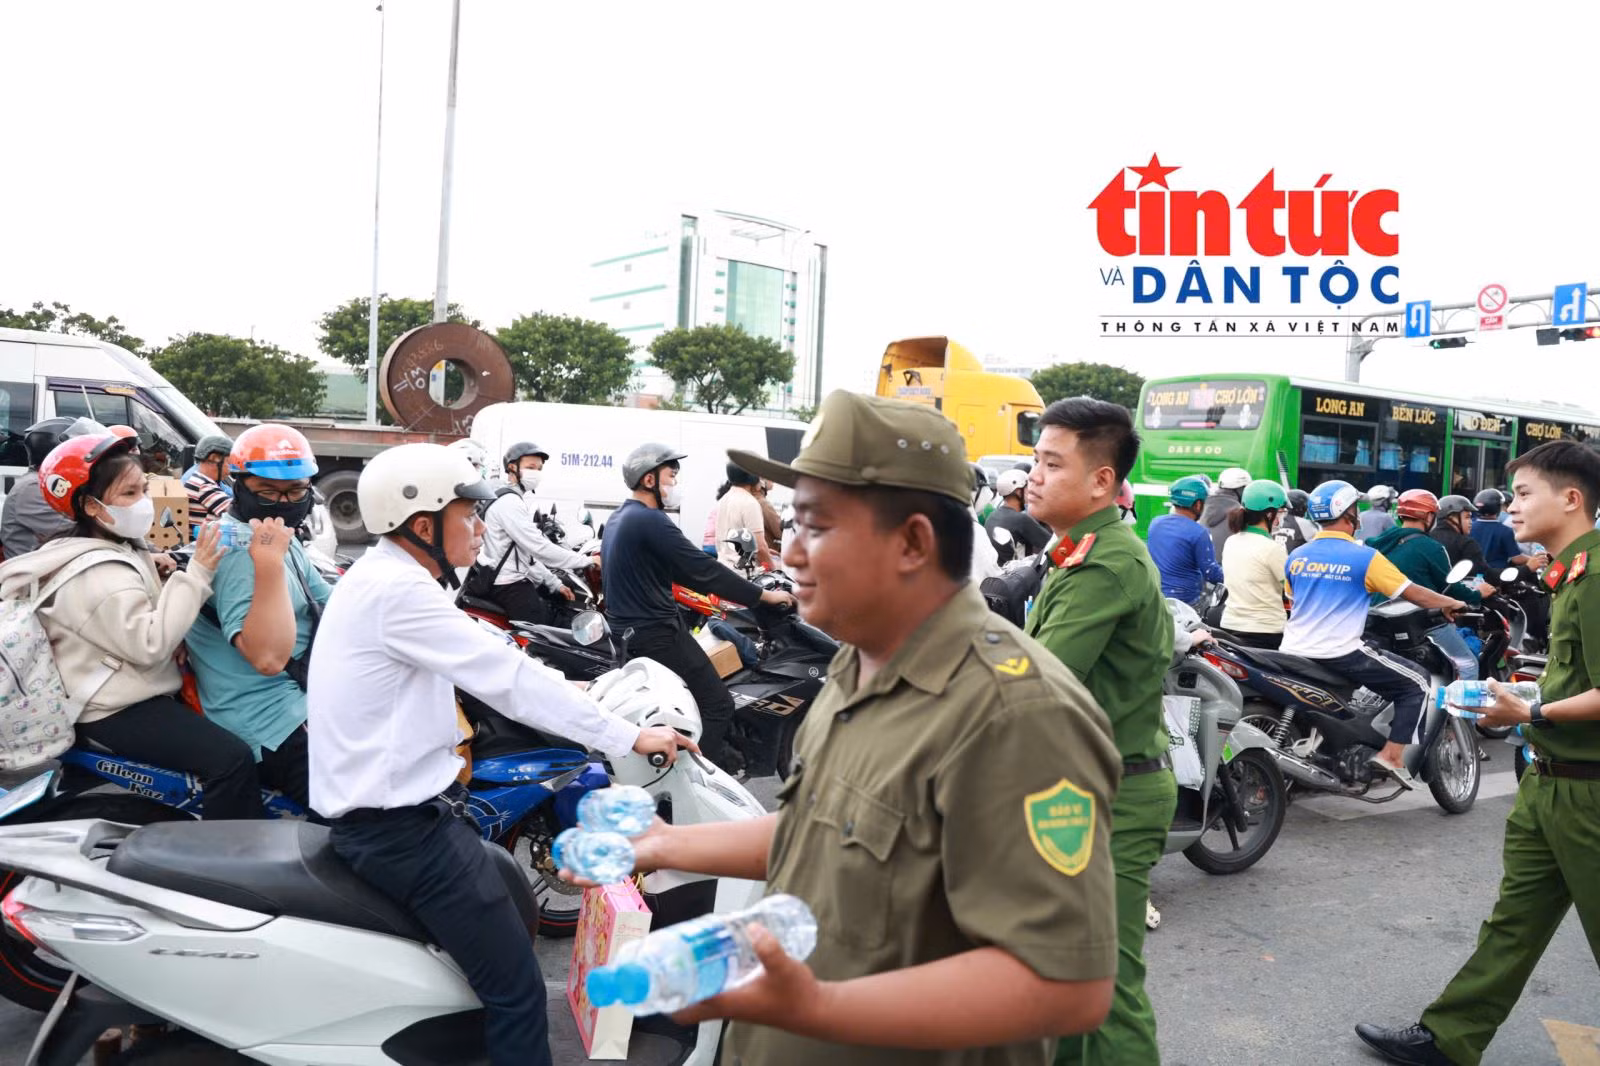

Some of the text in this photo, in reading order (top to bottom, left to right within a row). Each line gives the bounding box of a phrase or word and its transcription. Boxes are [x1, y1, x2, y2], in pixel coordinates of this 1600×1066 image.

[1315, 397, 1365, 417] LONG AN
[561, 452, 613, 468] 51M-212.44
[1306, 561, 1351, 574] ONVIP
